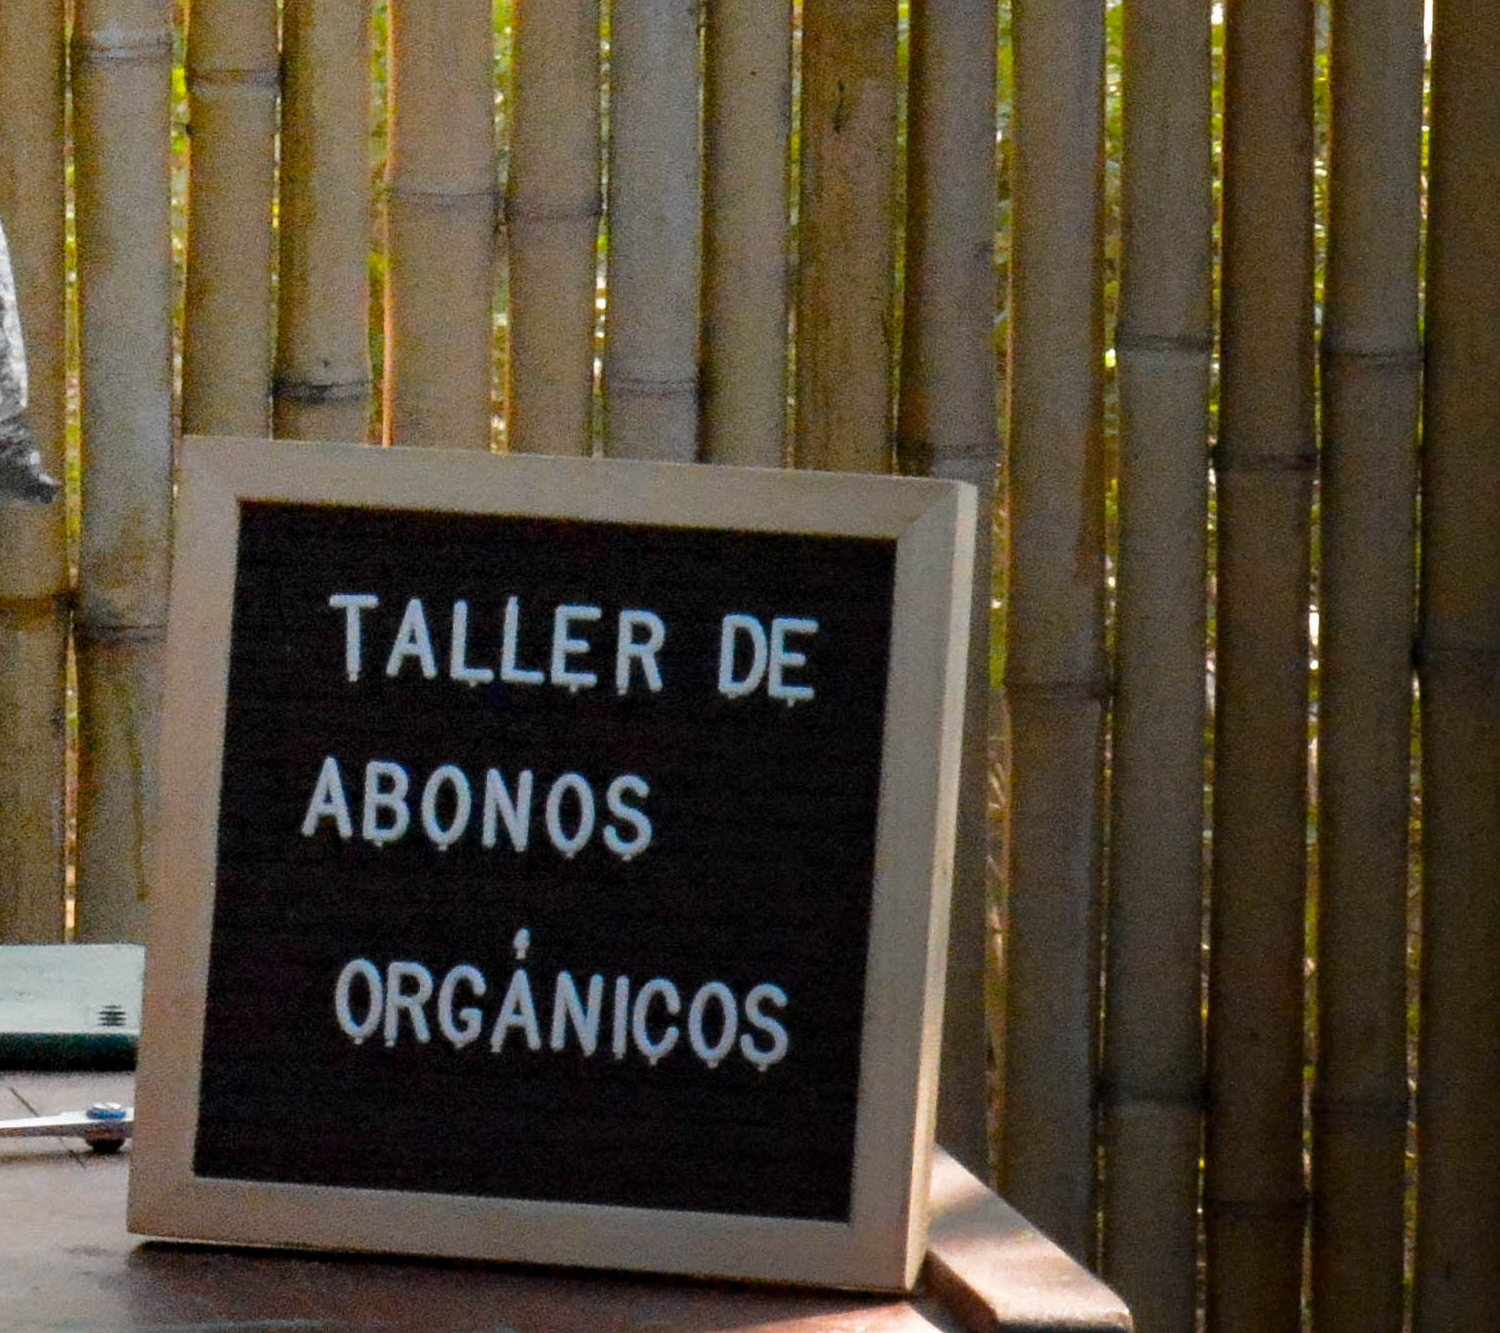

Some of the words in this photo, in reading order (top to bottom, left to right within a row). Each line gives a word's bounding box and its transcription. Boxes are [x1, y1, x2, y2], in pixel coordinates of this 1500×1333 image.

[328, 593, 666, 696] TALLER
[717, 613, 819, 707] DE
[300, 755, 653, 862] ABONOS
[334, 927, 789, 1071] ORGÁNICOS
